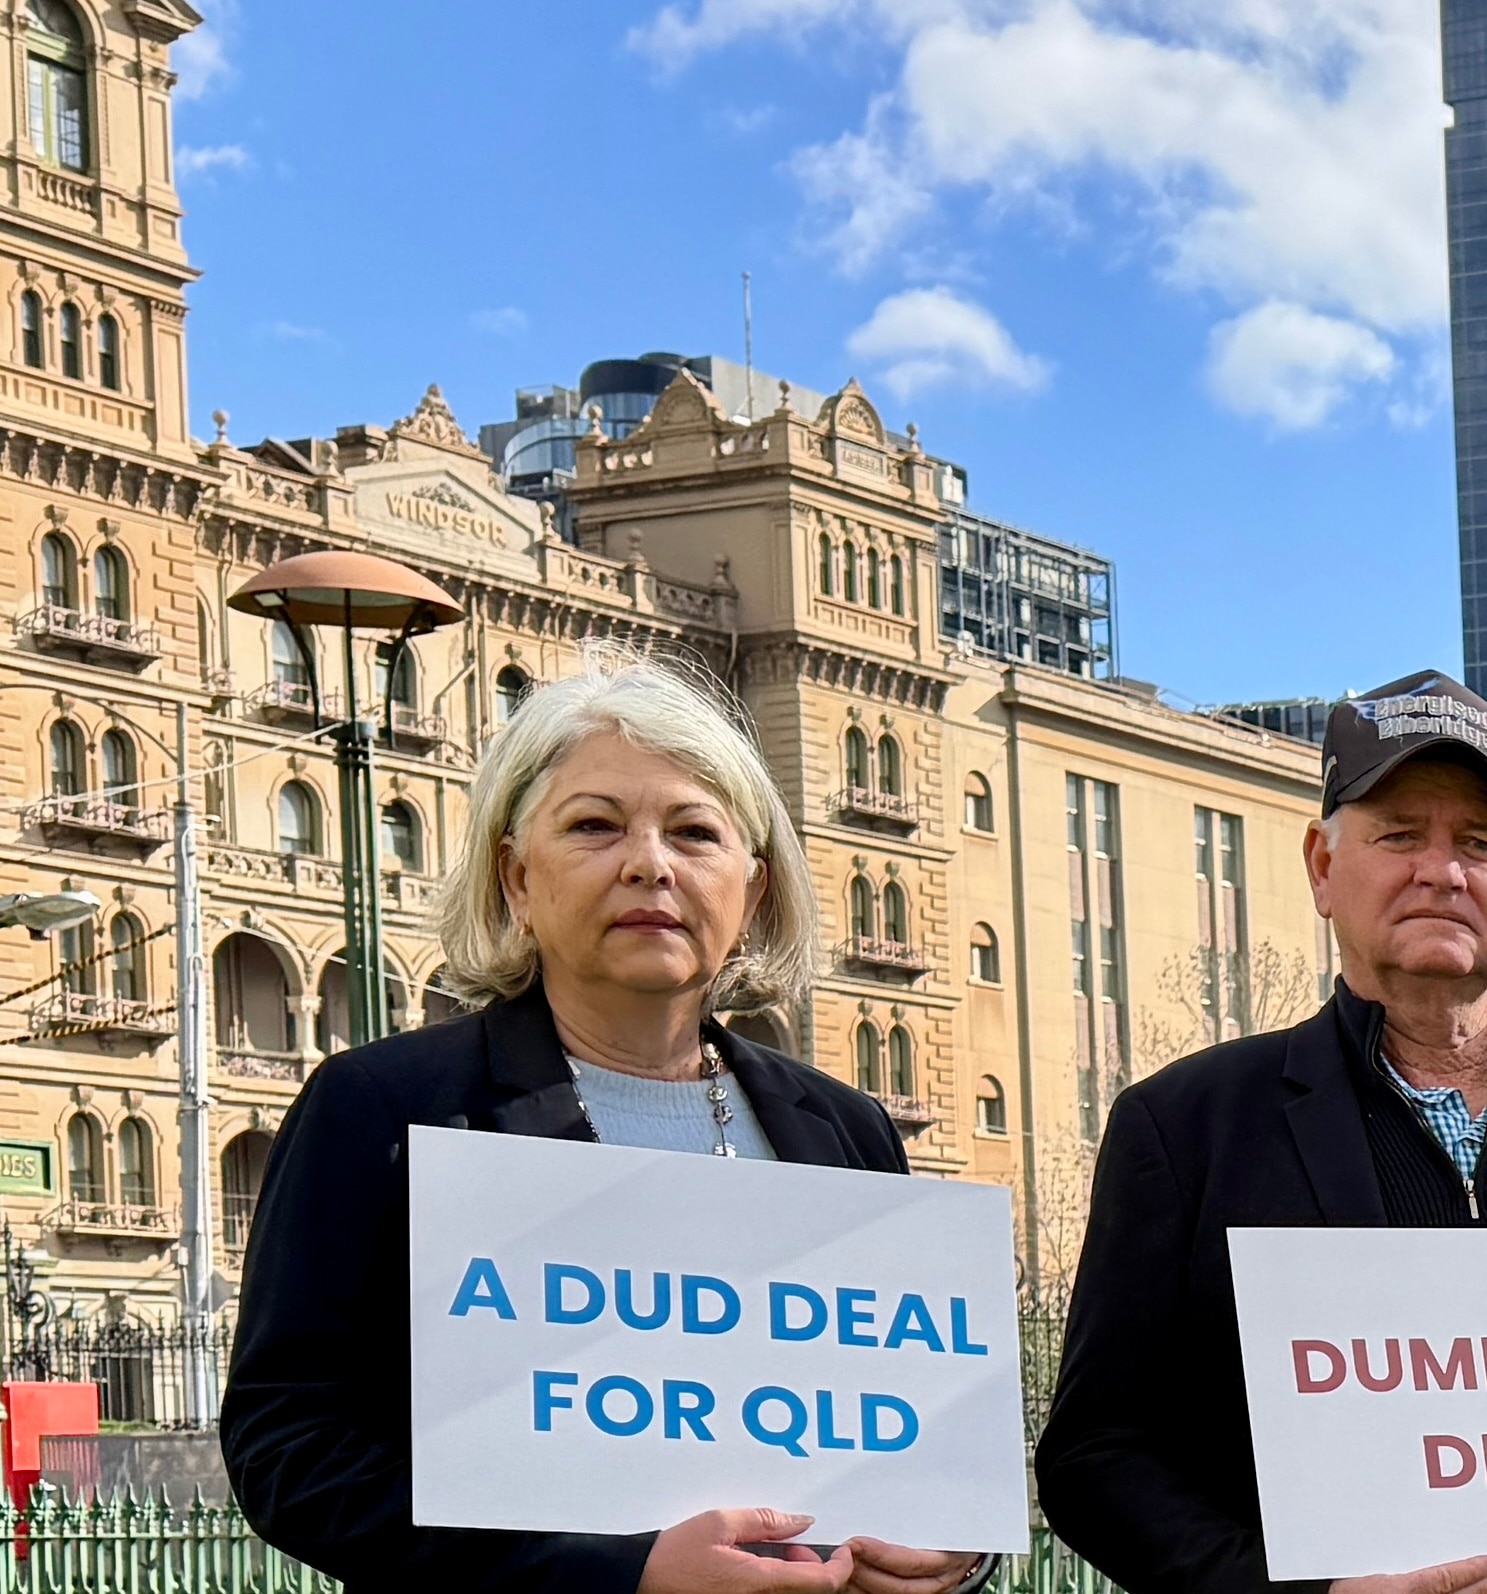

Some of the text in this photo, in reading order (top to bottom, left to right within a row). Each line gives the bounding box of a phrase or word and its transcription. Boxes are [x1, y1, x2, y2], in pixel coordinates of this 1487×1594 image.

[386, 492, 508, 549] WINDSOR
[0, 1153, 37, 1178] IES
[449, 1258, 988, 1355] A DUD DEAL
[533, 1371, 918, 1457] FOR QLD
